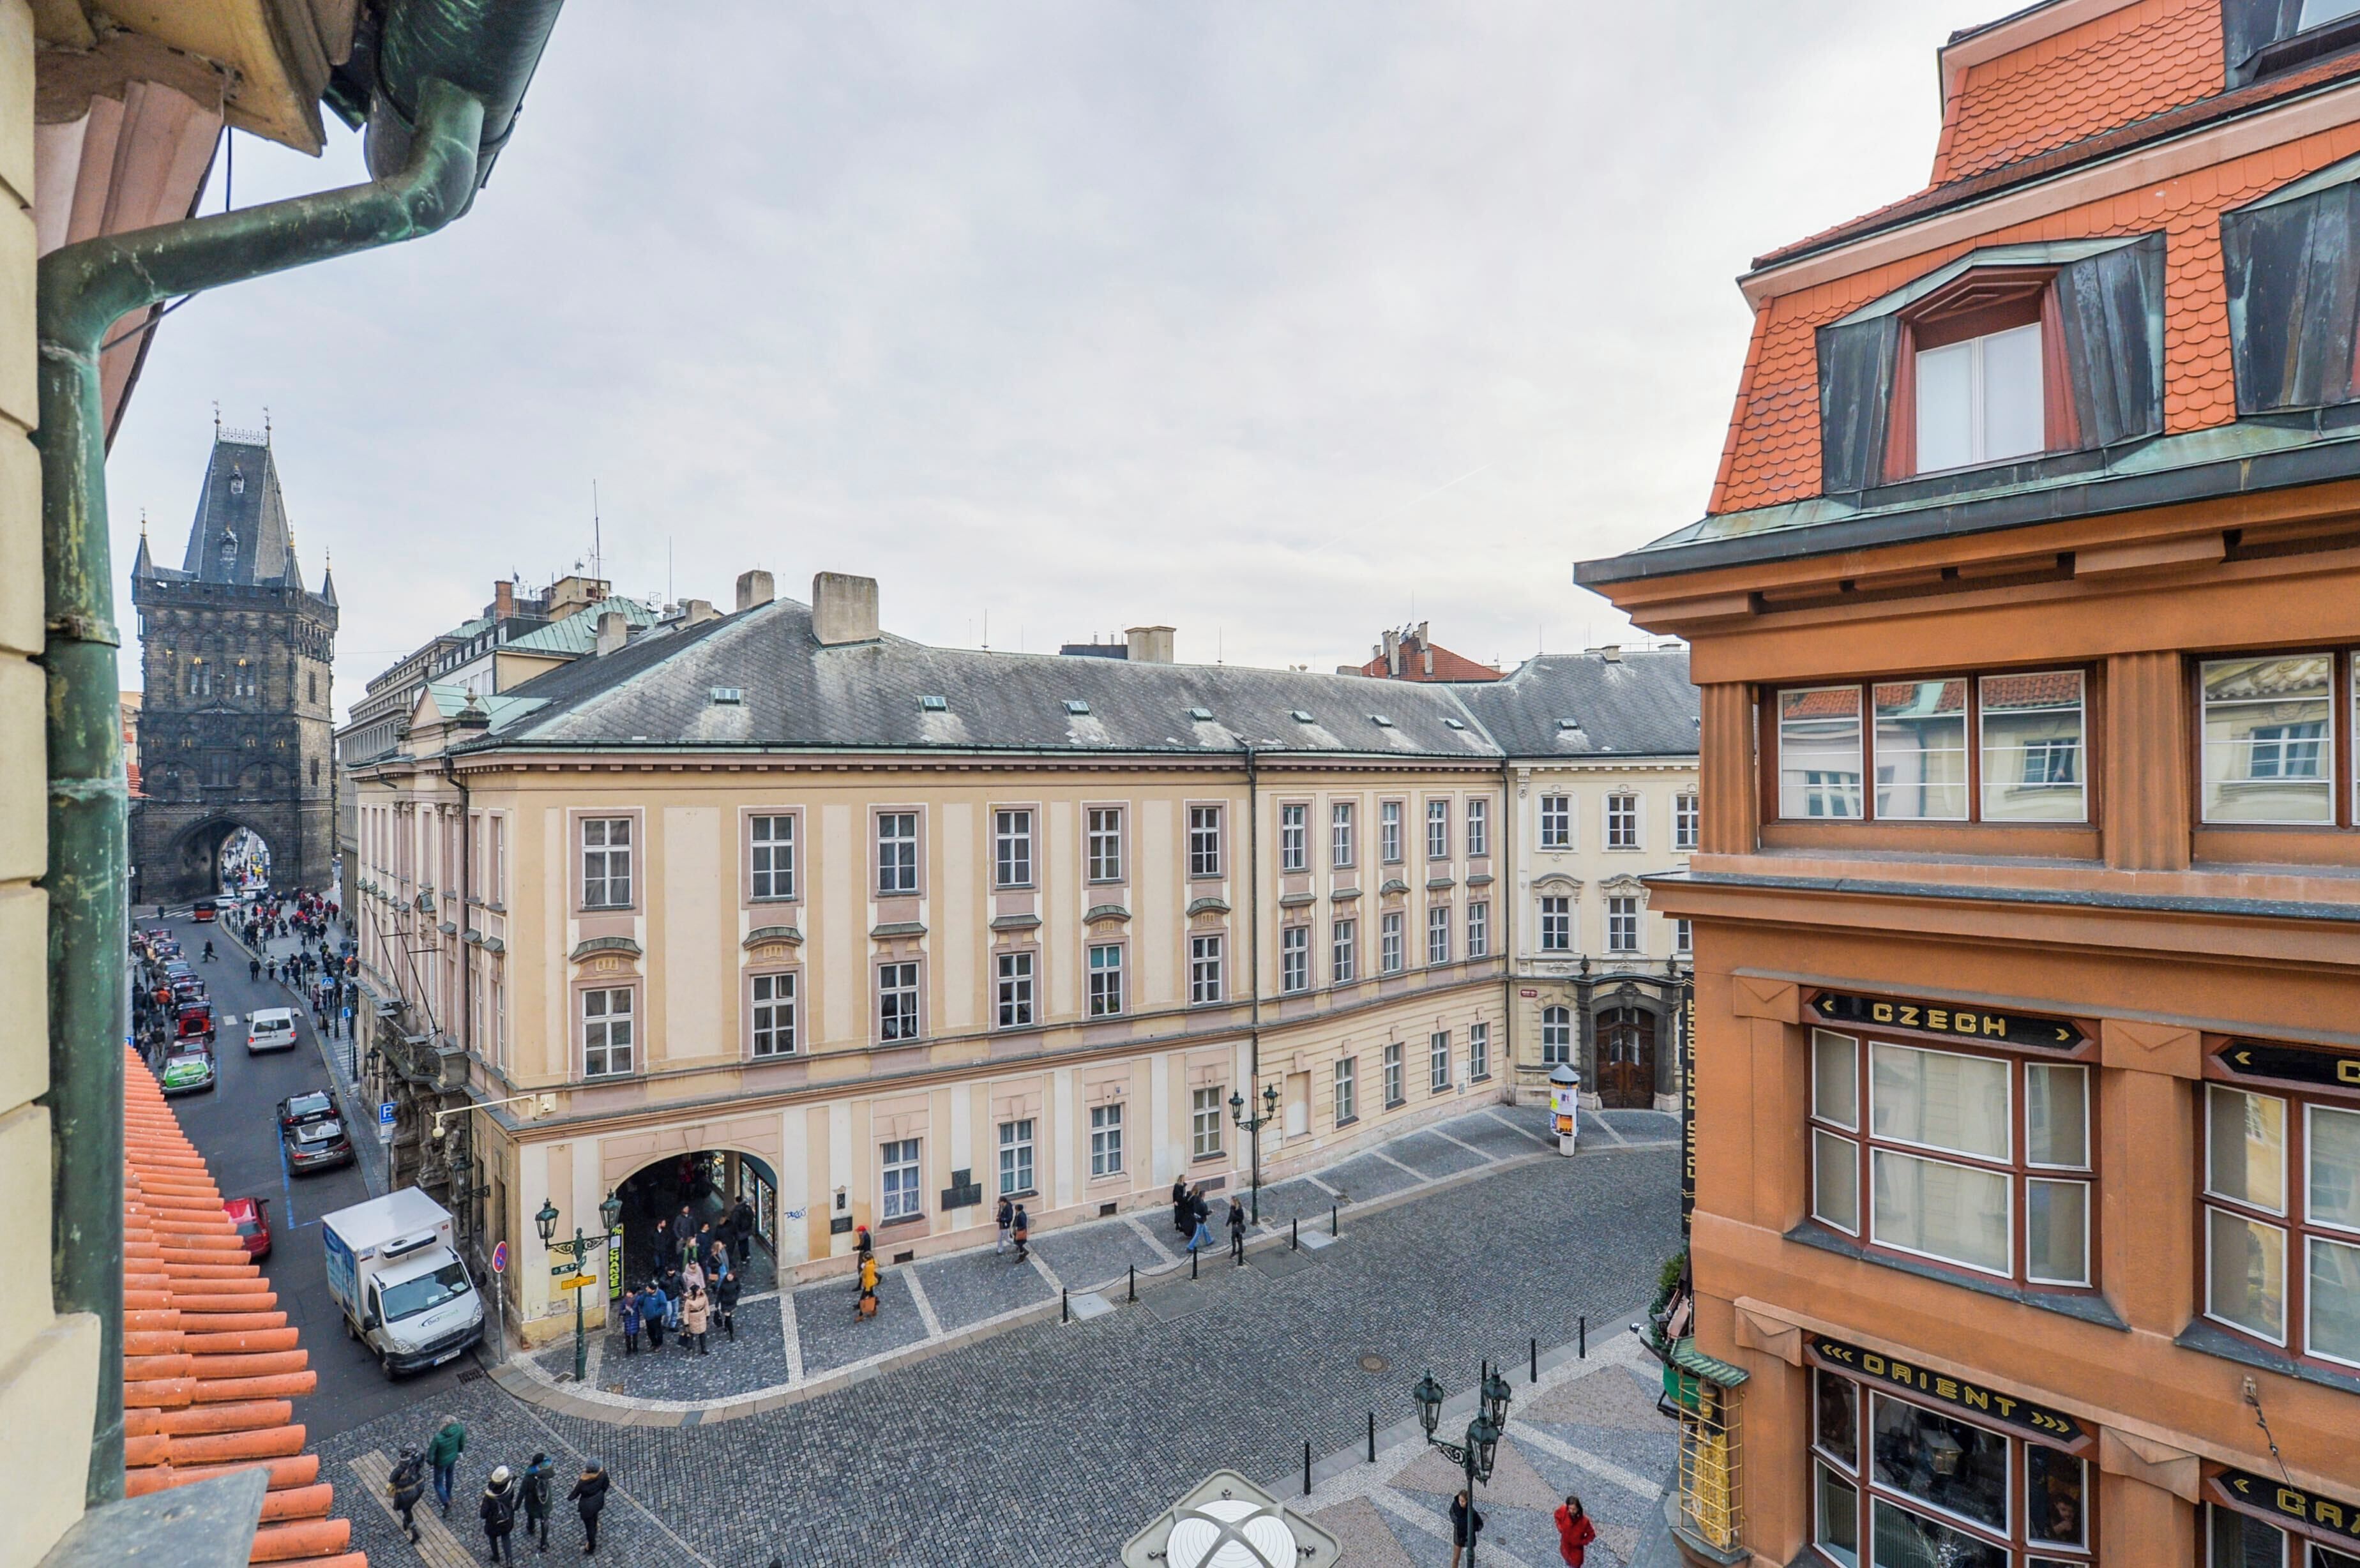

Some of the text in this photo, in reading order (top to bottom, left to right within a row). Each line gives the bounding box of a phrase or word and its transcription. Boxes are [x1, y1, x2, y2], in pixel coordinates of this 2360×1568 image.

[1873, 1003, 2005, 1037] CZECH
[610, 1248, 620, 1287] CHANGE
[1863, 1354, 2016, 1417] ORIENT
